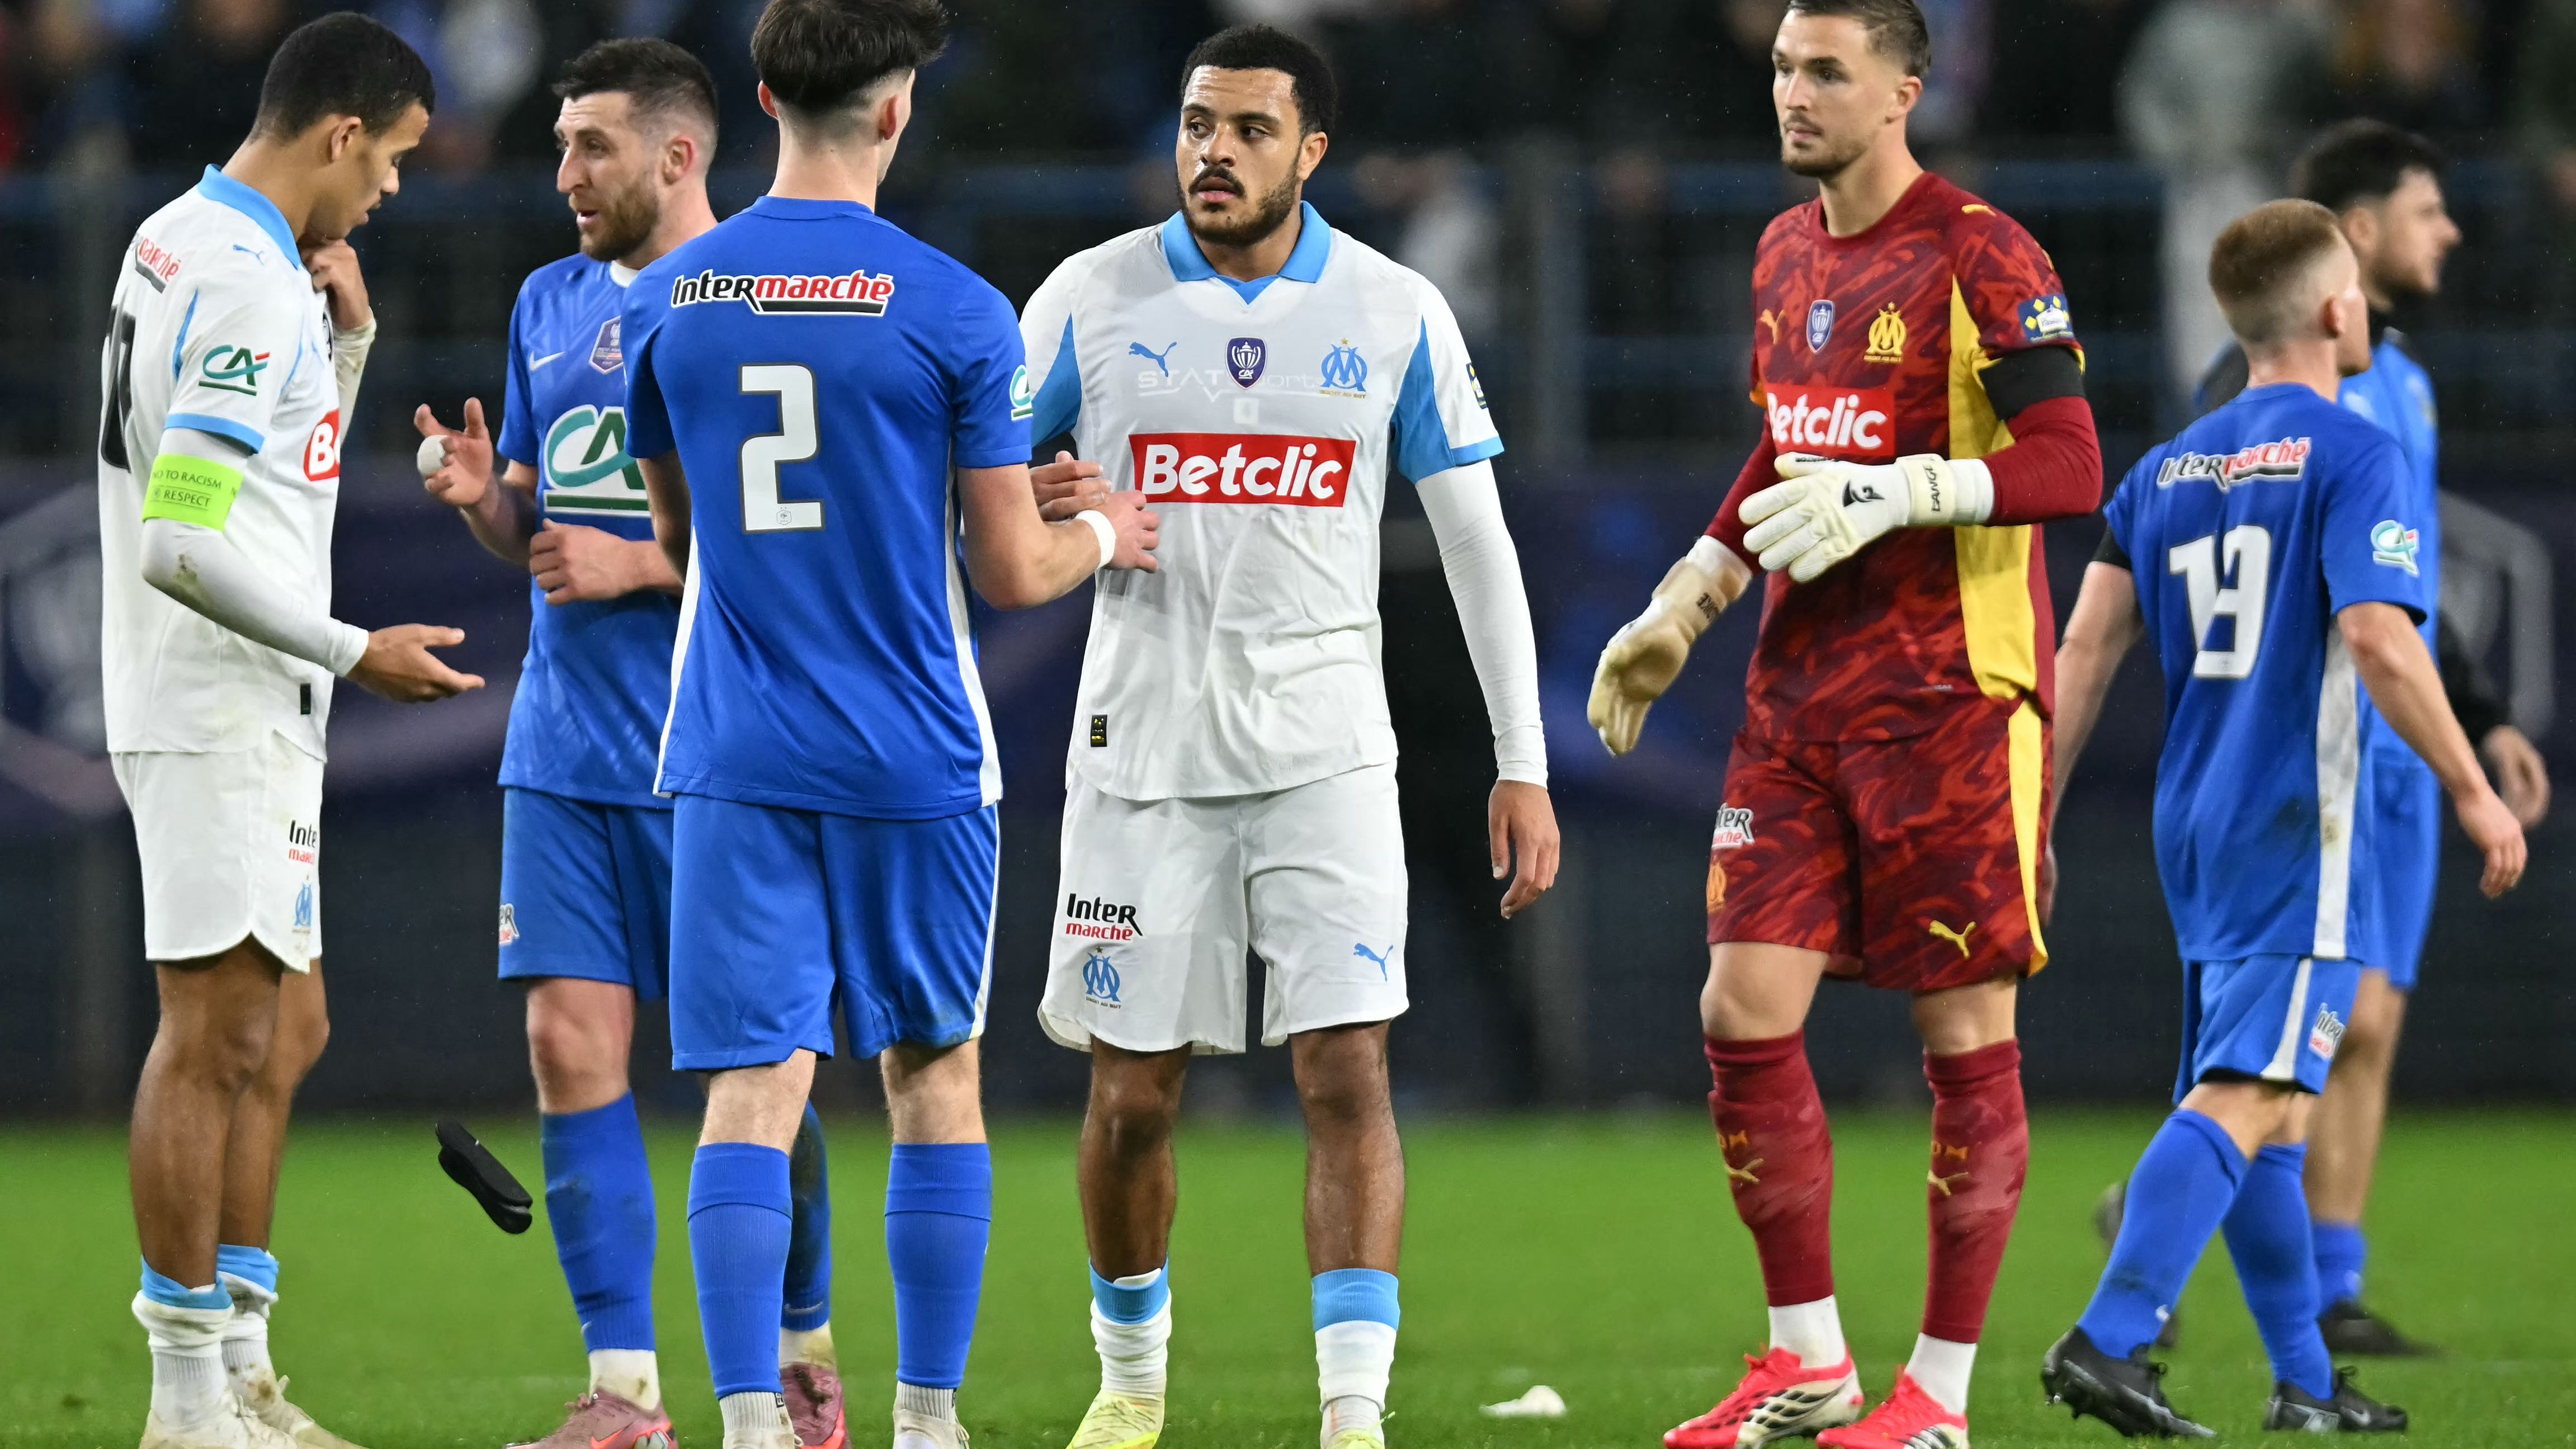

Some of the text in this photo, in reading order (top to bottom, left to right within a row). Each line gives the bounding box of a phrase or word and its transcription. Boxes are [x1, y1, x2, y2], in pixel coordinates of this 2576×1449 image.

[673, 271, 893, 312] Intermarché
[740, 364, 823, 532] 2
[166, 470, 179, 480] TO
[181, 471, 222, 490] RACISM
[1142, 443, 1343, 499] Betclic
[164, 489, 212, 507] RESPECT
[2169, 525, 2271, 679] 19
[1067, 893, 1143, 936] Inter
